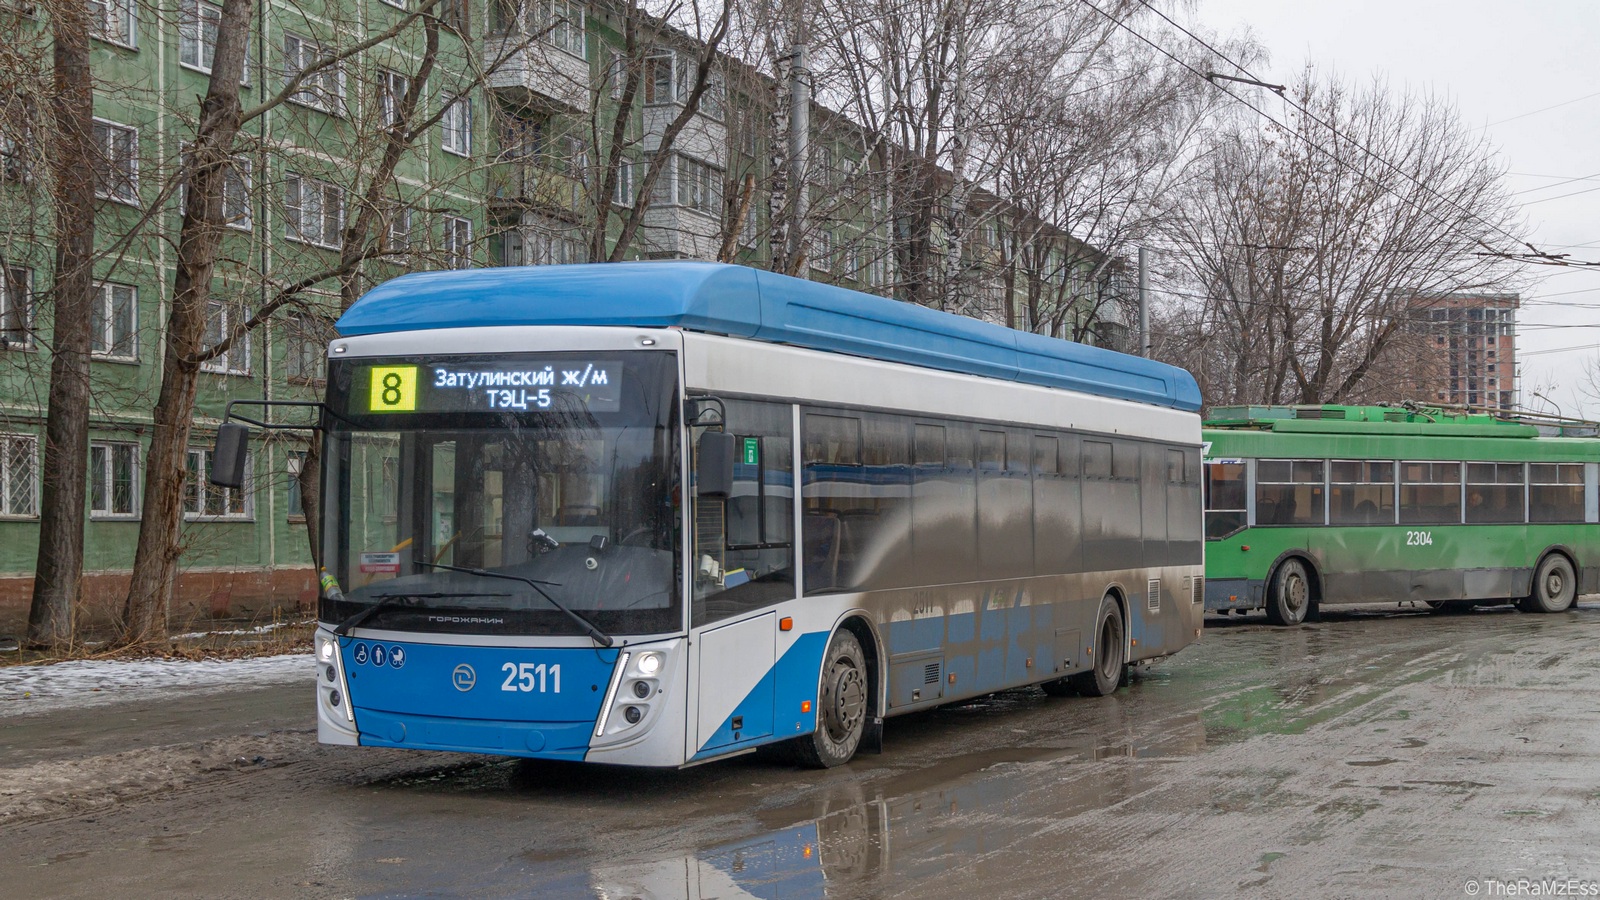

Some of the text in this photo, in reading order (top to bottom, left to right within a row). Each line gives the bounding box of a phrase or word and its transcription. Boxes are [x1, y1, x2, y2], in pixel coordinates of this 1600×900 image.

[434, 363, 608, 389] Затулинский ж/м
[382, 373, 402, 405] 8
[486, 389, 551, 410] ТЭЦ-5
[1406, 531, 1433, 546] 2304
[428, 615, 504, 624] ГОРОЖАНИН
[501, 662, 561, 693] 2511
